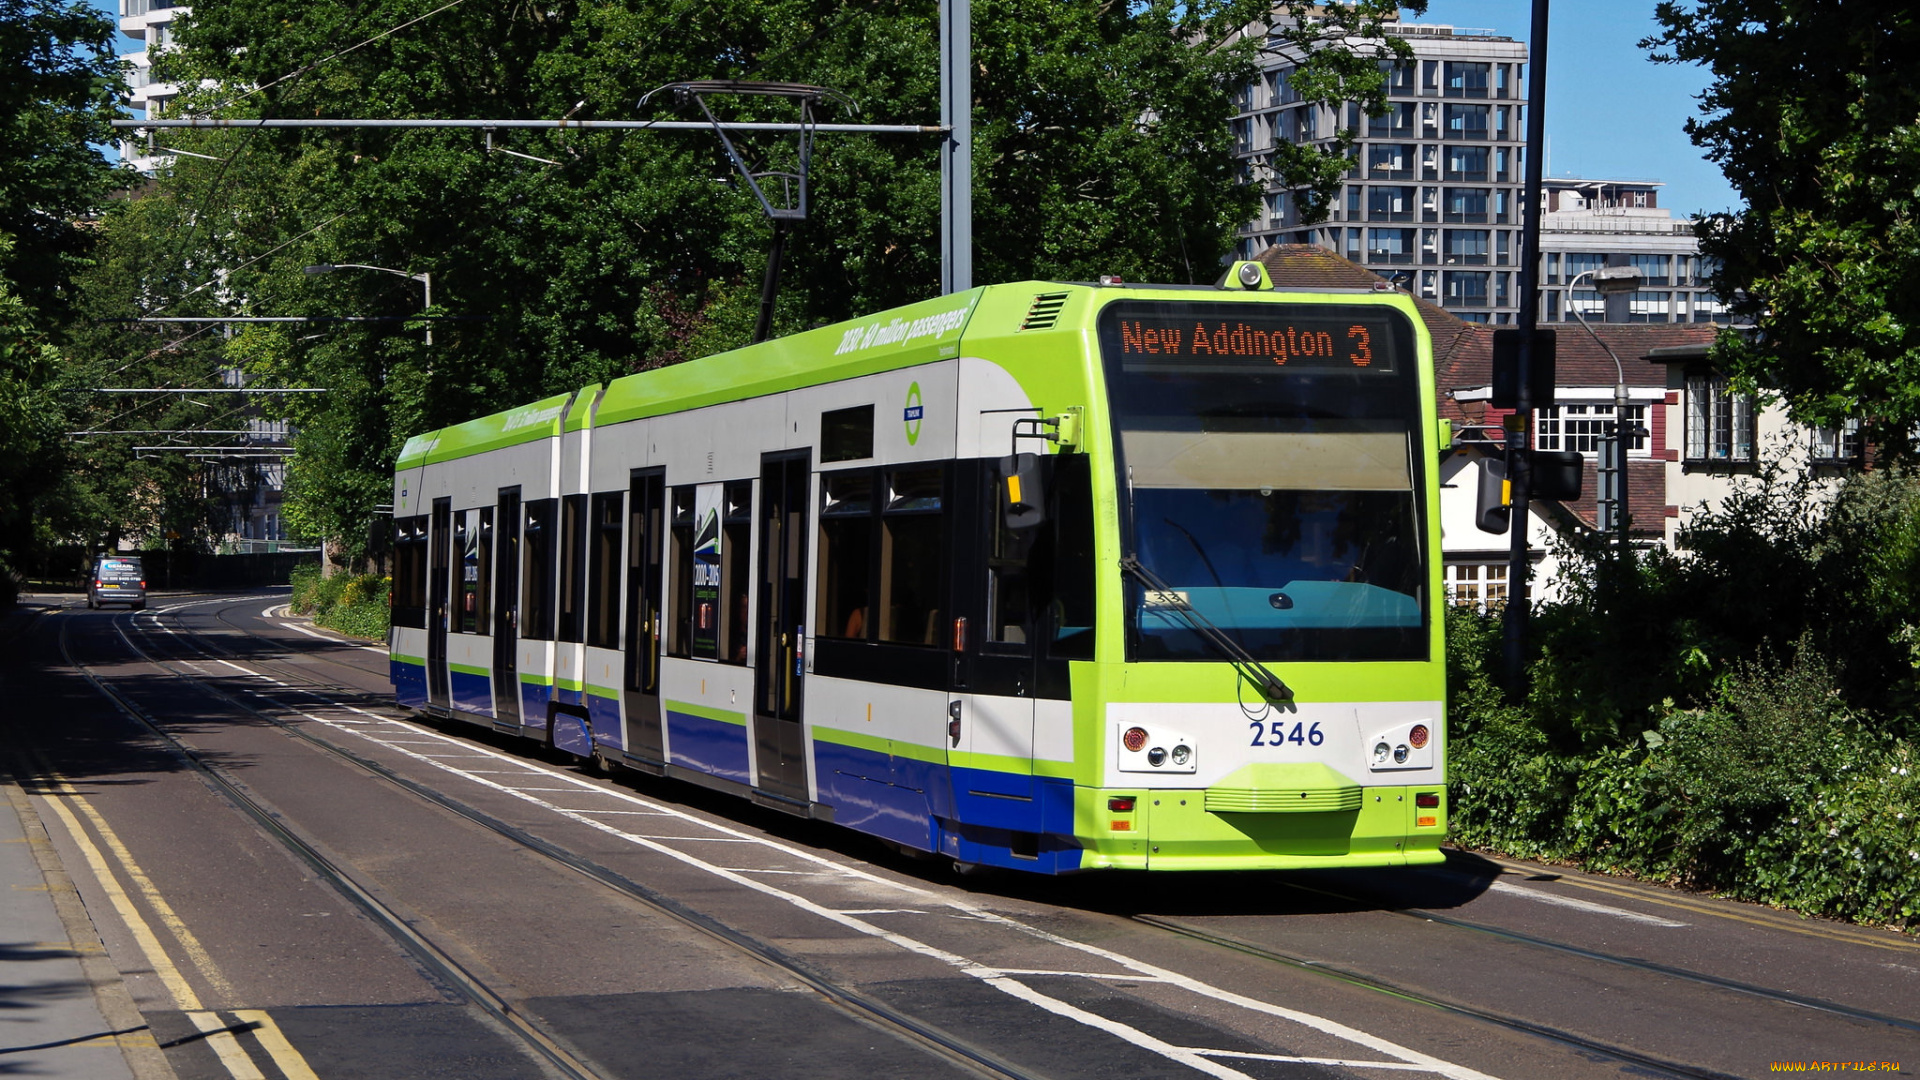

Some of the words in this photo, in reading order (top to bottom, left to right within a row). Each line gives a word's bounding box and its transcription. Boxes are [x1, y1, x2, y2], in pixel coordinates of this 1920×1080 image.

[859, 322, 880, 350] 60
[872, 317, 909, 347] million
[1121, 321, 1181, 354] New
[1192, 322, 1333, 365] Addington
[1347, 325, 1372, 367] 3
[1249, 721, 1324, 747] 2546
